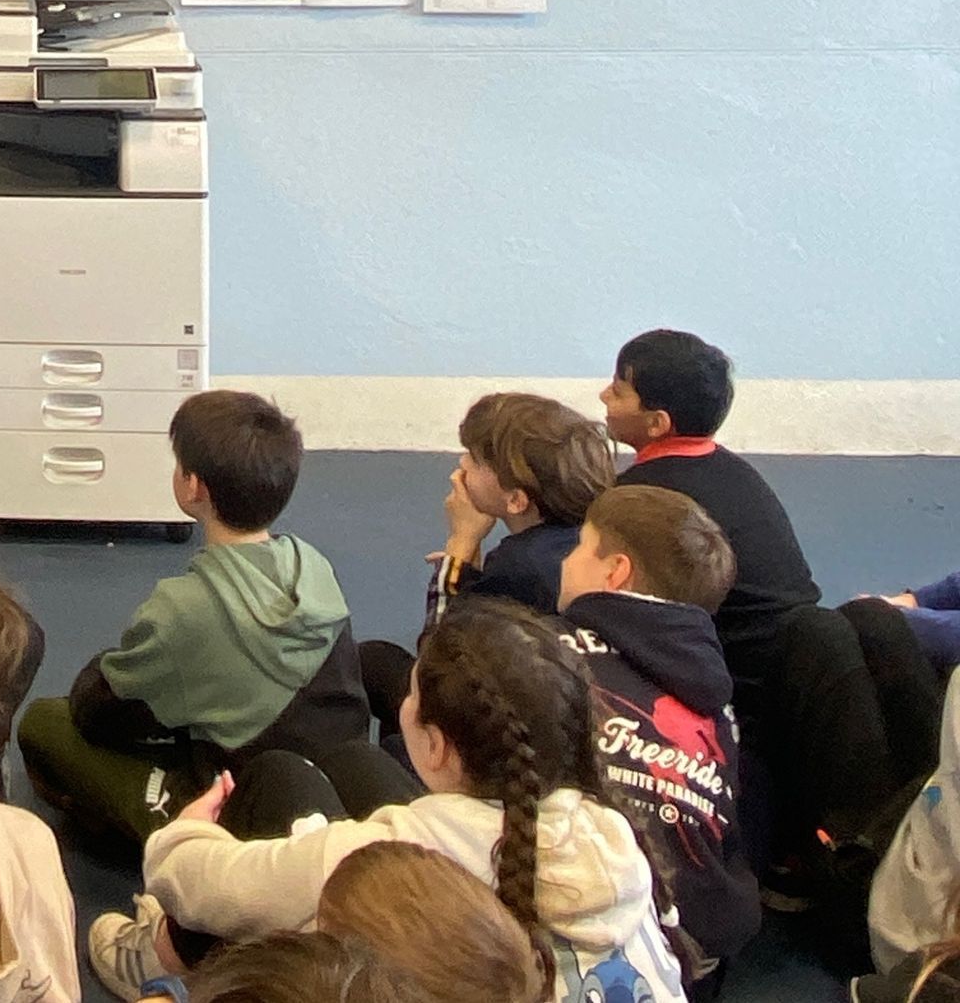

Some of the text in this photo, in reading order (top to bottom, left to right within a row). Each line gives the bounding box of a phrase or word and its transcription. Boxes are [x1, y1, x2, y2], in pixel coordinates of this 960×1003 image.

[598, 717, 723, 794] Freeride
[607, 765, 655, 791] WHITE
[656, 777, 716, 817] PARADISE
